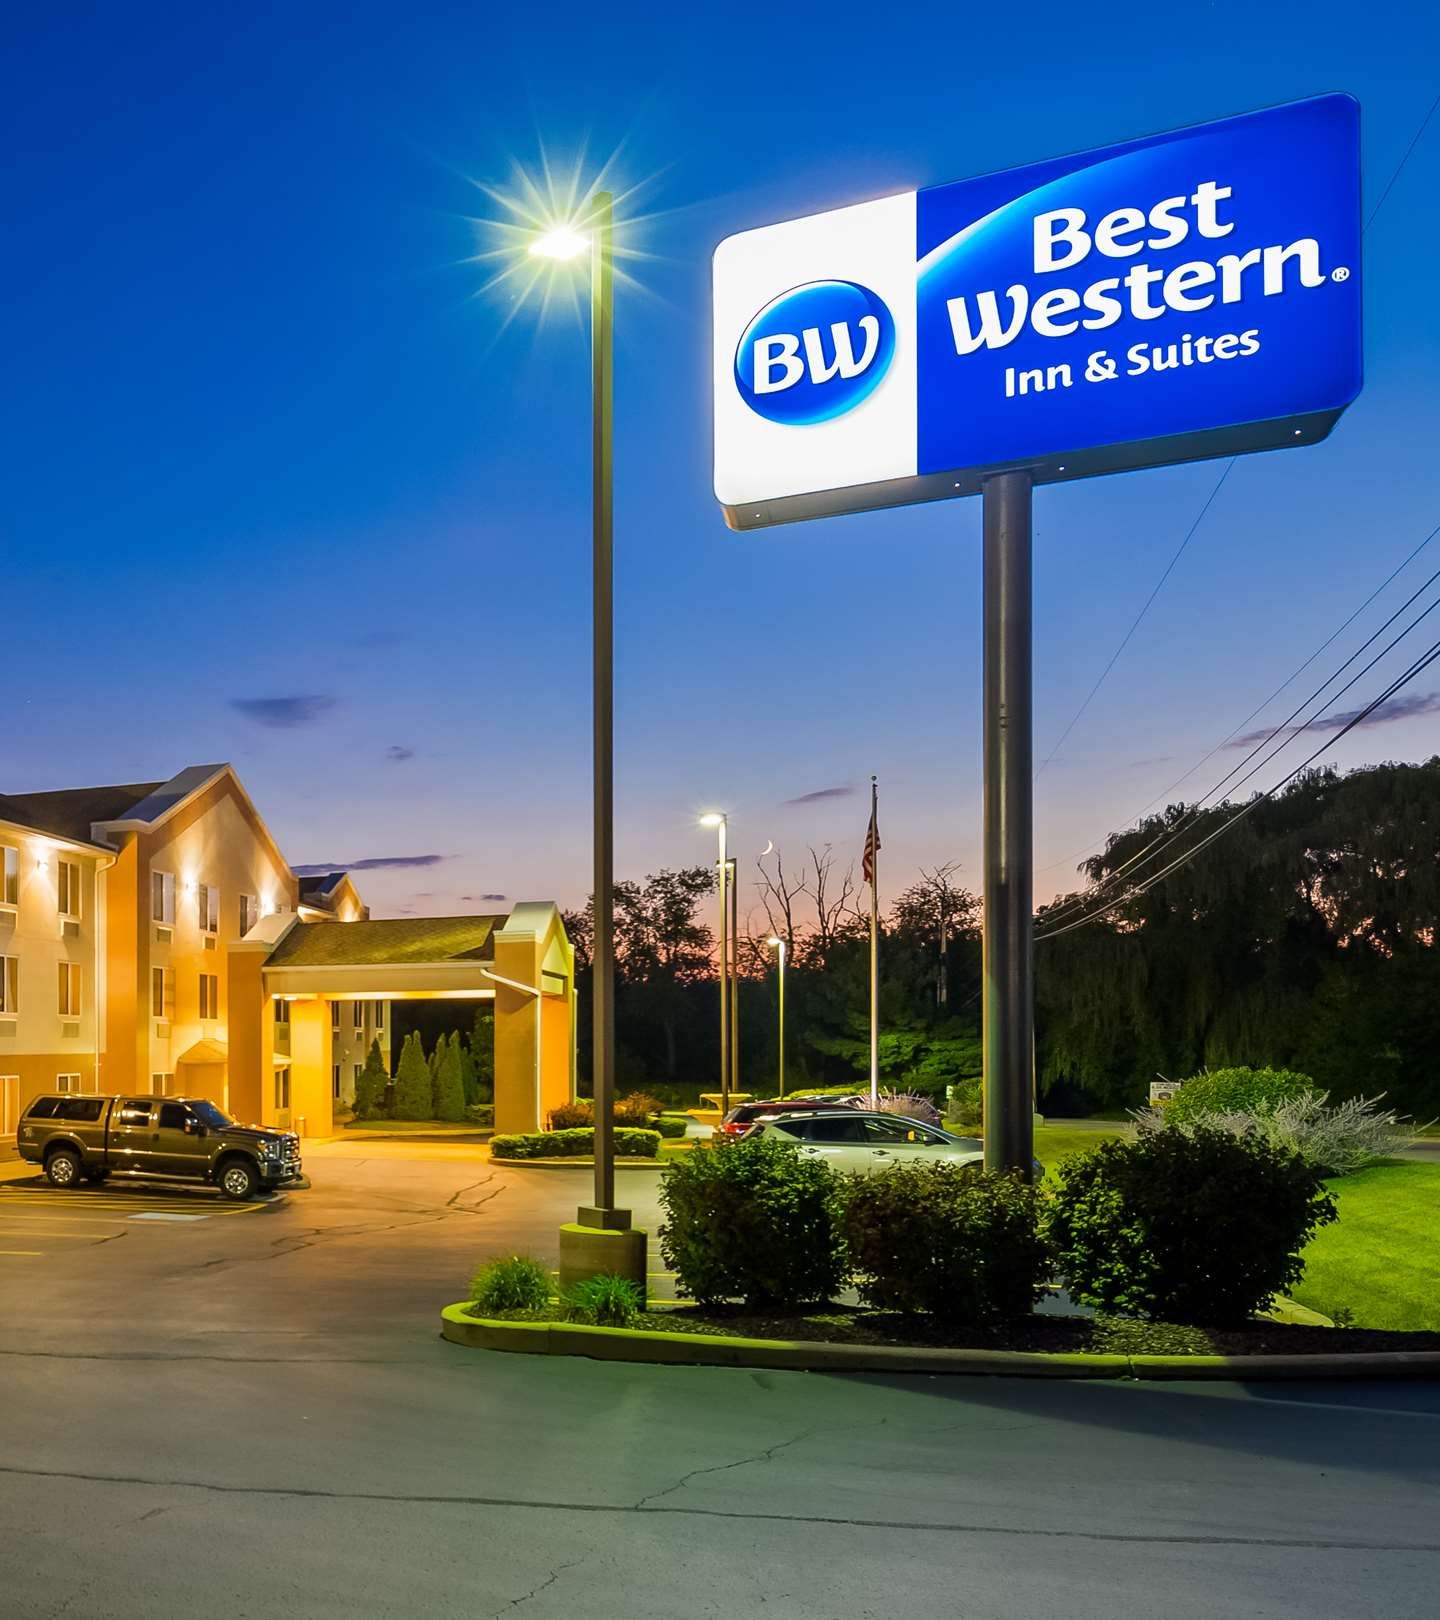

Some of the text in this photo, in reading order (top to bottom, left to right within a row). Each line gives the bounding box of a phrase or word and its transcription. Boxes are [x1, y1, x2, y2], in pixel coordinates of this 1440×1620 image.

[1034, 181, 1235, 275] Best
[753, 315, 880, 394] BW
[1005, 329, 1260, 397] Inn & Suites
